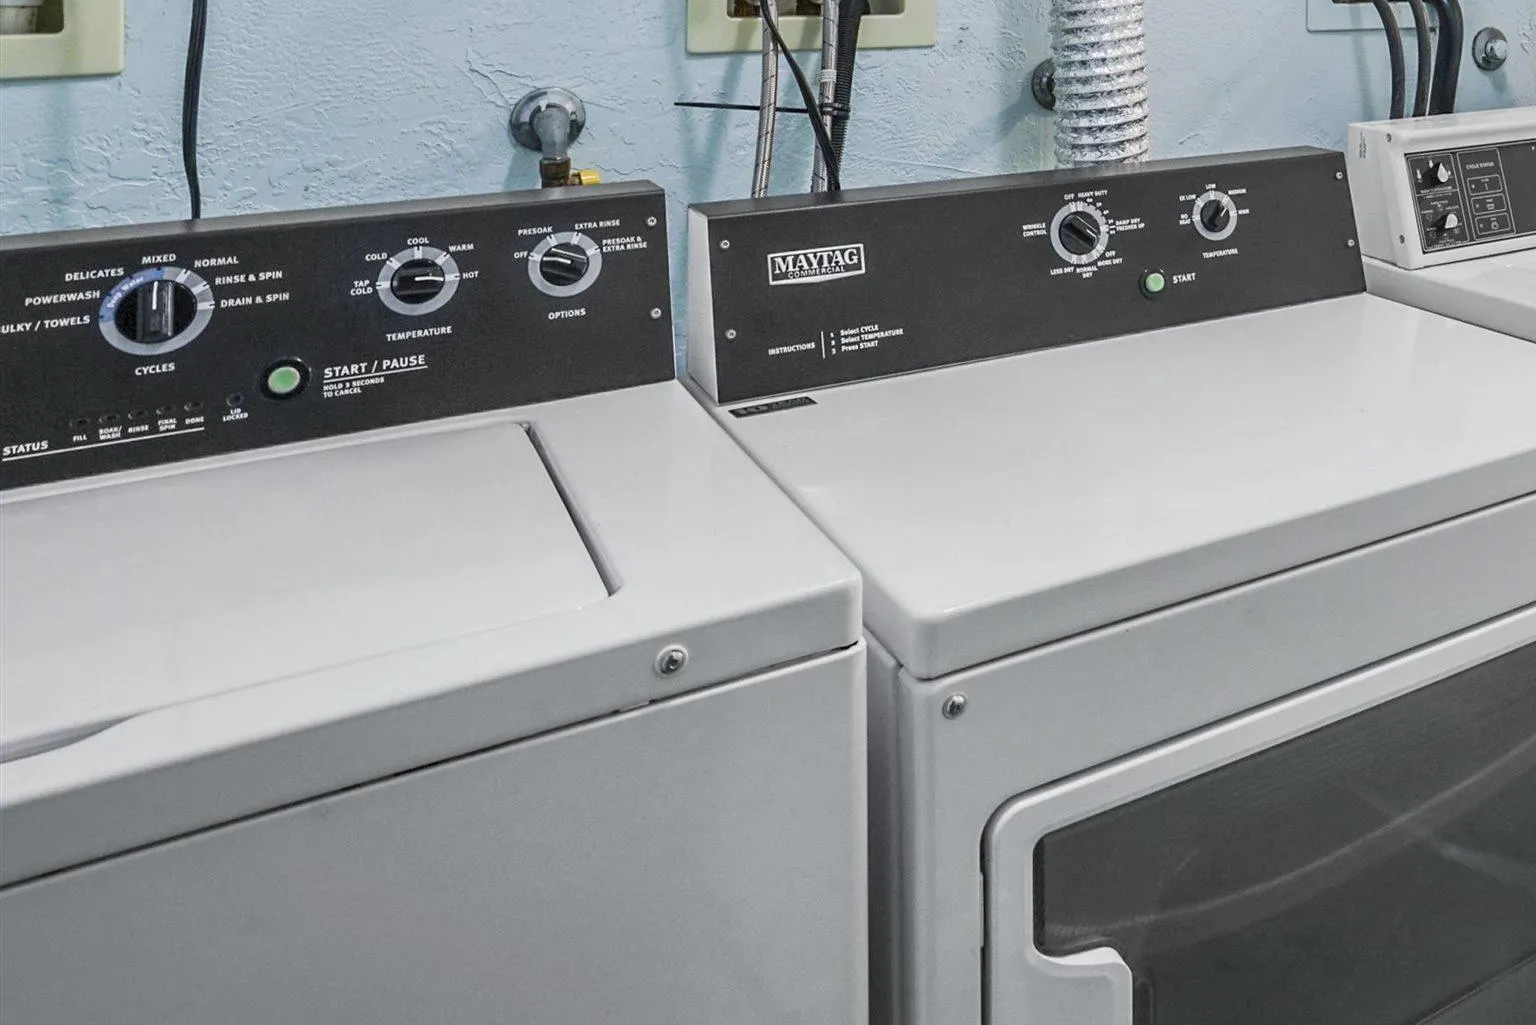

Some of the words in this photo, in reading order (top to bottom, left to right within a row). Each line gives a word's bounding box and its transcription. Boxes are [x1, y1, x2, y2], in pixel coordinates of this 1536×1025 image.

[575, 222, 598, 230] EXTRA
[599, 219, 620, 228] RINSE
[518, 226, 552, 236] PRESOAK
[407, 237, 429, 246] COOL
[602, 237, 636, 245] PRESOAK
[449, 243, 474, 252] WARM
[603, 245, 625, 253] EXTRA
[626, 242, 647, 250] RINSE
[1202, 248, 1238, 258] TEMPERATURE
[142, 253, 176, 265] MIXED
[365, 252, 387, 261] COLD
[514, 251, 528, 259] OFF
[194, 256, 239, 268] NORMAL
[774, 248, 858, 274] MAYTAG
[64, 267, 125, 282] DELICATES
[215, 273, 246, 285] RINSE
[248, 273, 256, 283] &
[259, 270, 283, 281] SPIN
[463, 271, 479, 279] HOT
[787, 266, 846, 279] COMMERCIAL
[353, 280, 370, 288] TAP
[1173, 273, 1196, 284] START
[351, 287, 373, 296] COLD
[25, 290, 100, 307] POWERWASH
[220, 295, 252, 309] DRAIN
[255, 294, 263, 305] &
[265, 292, 290, 303] SPIN
[548, 308, 586, 320] OPTIONS
[0, 322, 32, 334] ULKY
[34, 320, 41, 332] /
[44, 315, 91, 328] TOWELS
[386, 326, 452, 341] TEMPERATURE
[840, 328, 860, 337] Select
[860, 324, 878, 332] CYCLE
[841, 336, 860, 344] Select
[861, 328, 903, 341] TEMPERATURE
[768, 342, 815, 355] INSTRUCTIONS
[860, 340, 878, 349] START
[135, 362, 176, 376] CYCLES
[323, 362, 368, 378] START
[371, 360, 378, 373] /
[383, 355, 425, 369] PAUSE
[323, 383, 343, 391] HOLD
[352, 377, 385, 387] SECONDS
[334, 387, 361, 397] CANCEL
[158, 417, 177, 426] FINAL
[185, 417, 204, 425] DONE
[222, 412, 249, 422] LOCKED
[99, 425, 122, 435] SOAK/
[128, 425, 149, 434] RINSE
[159, 424, 176, 432] SPIN
[73, 434, 87, 442] FILL
[100, 432, 121, 441] WASH
[2, 441, 49, 456] STATUS
